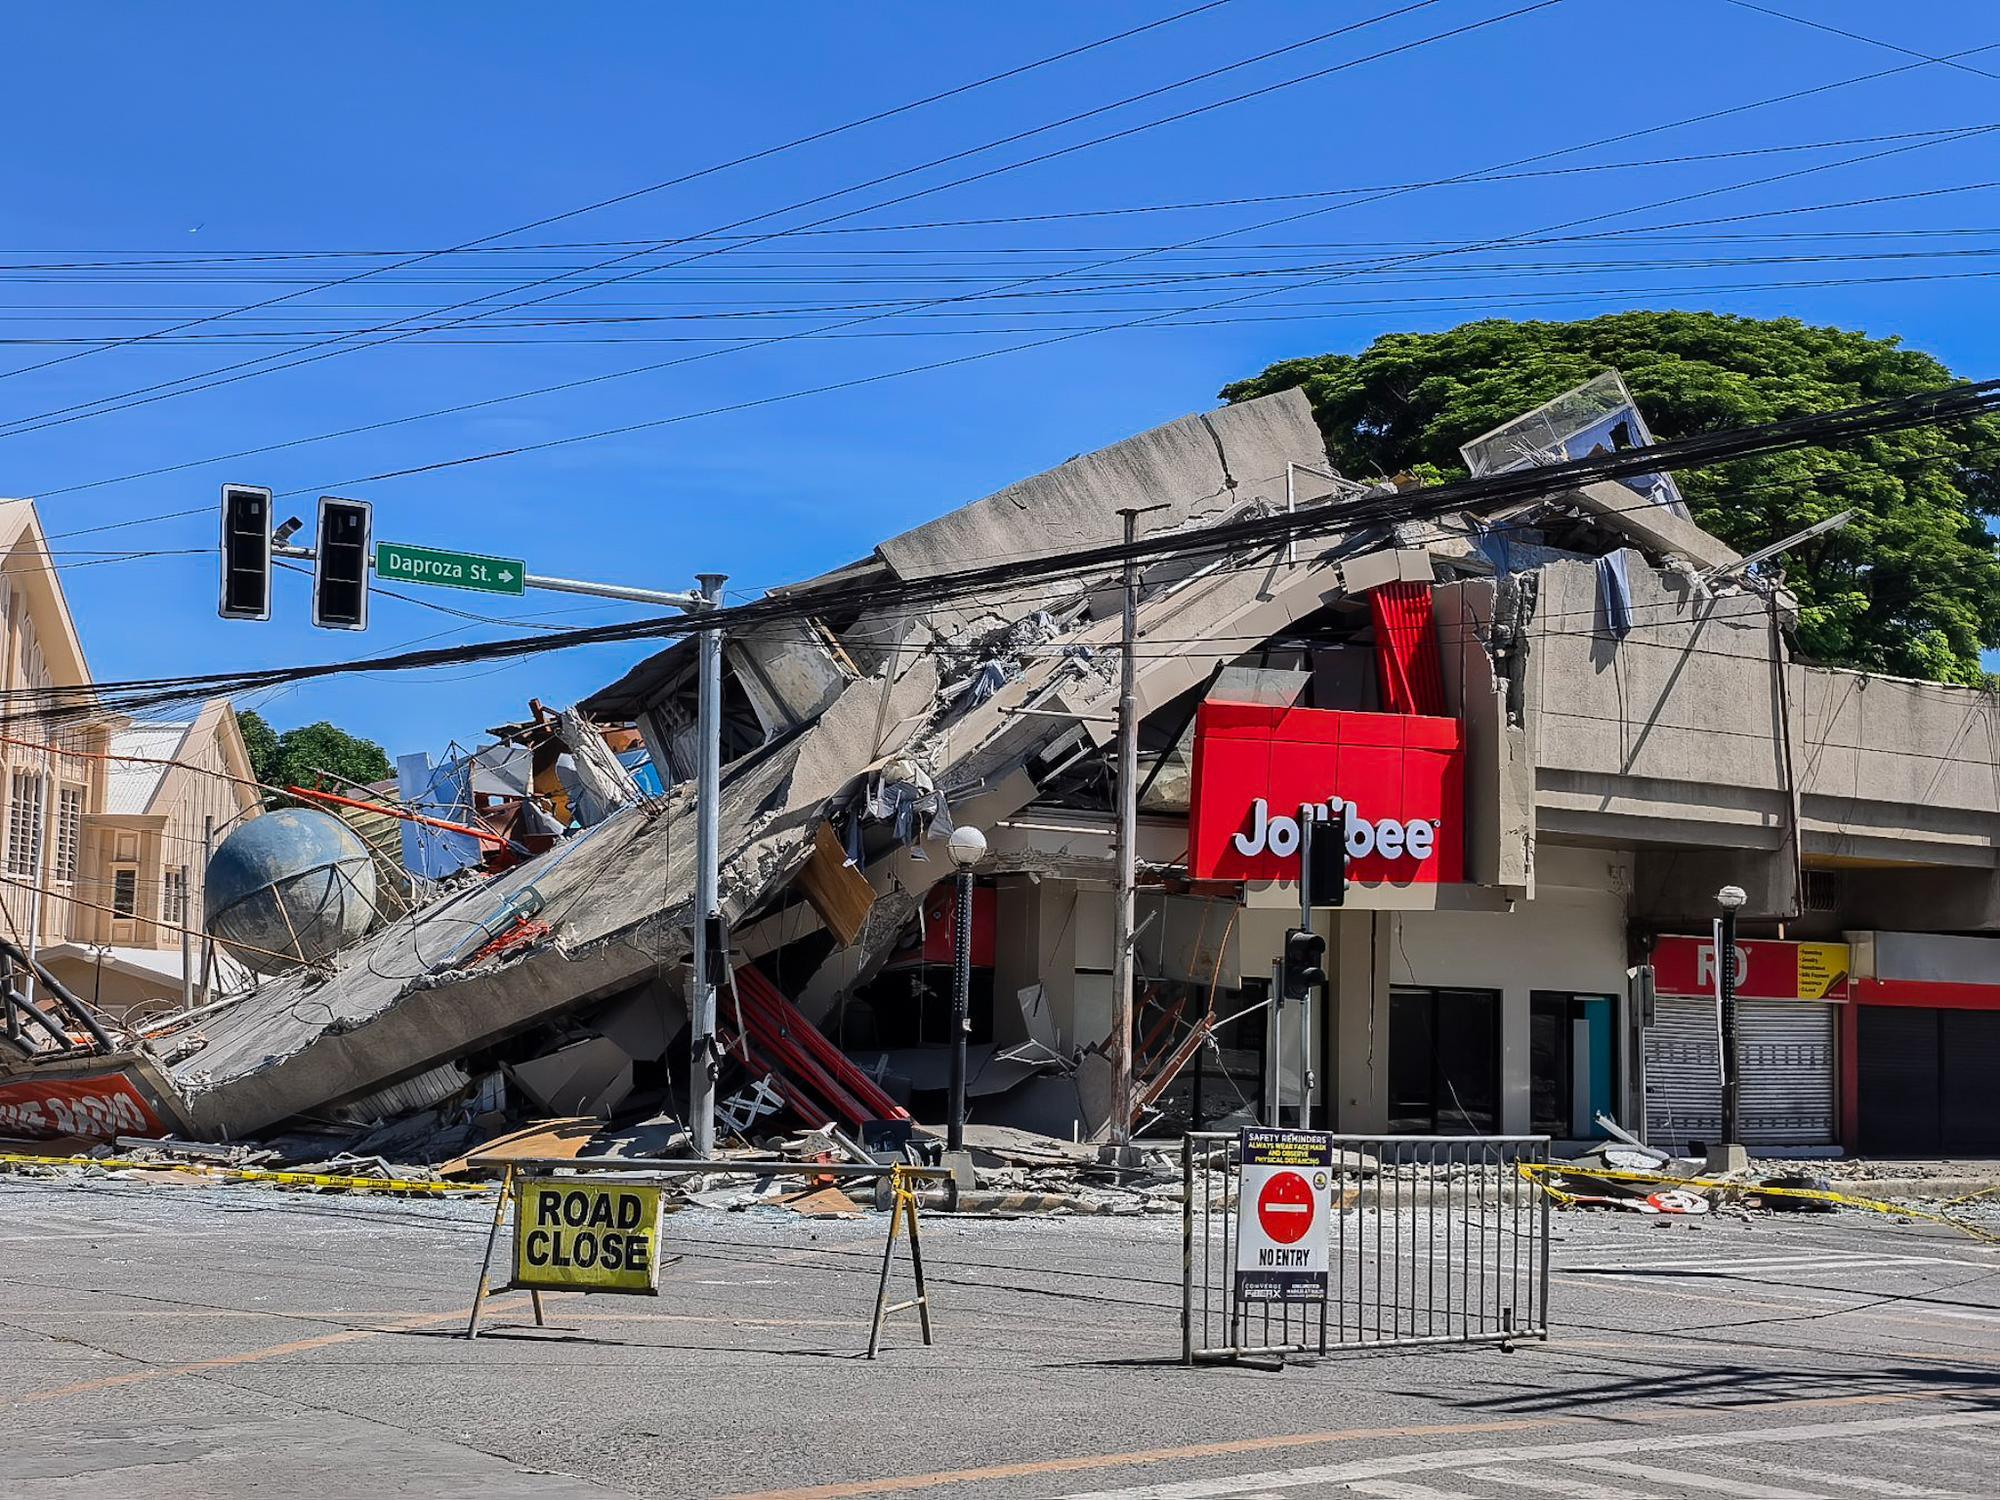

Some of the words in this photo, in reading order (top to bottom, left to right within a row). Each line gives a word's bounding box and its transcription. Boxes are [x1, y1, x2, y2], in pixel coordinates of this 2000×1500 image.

[390, 554, 462, 578] Daproza
[470, 564, 492, 582] St.
[1248, 1132, 1280, 1142] SAFETY
[1281, 1134, 1327, 1144] REMINDERS
[537, 1190, 642, 1230] ROAD
[526, 1230, 649, 1271] CLOSE
[1258, 1248, 1274, 1266] NO
[1276, 1249, 1310, 1267] ENTRY
